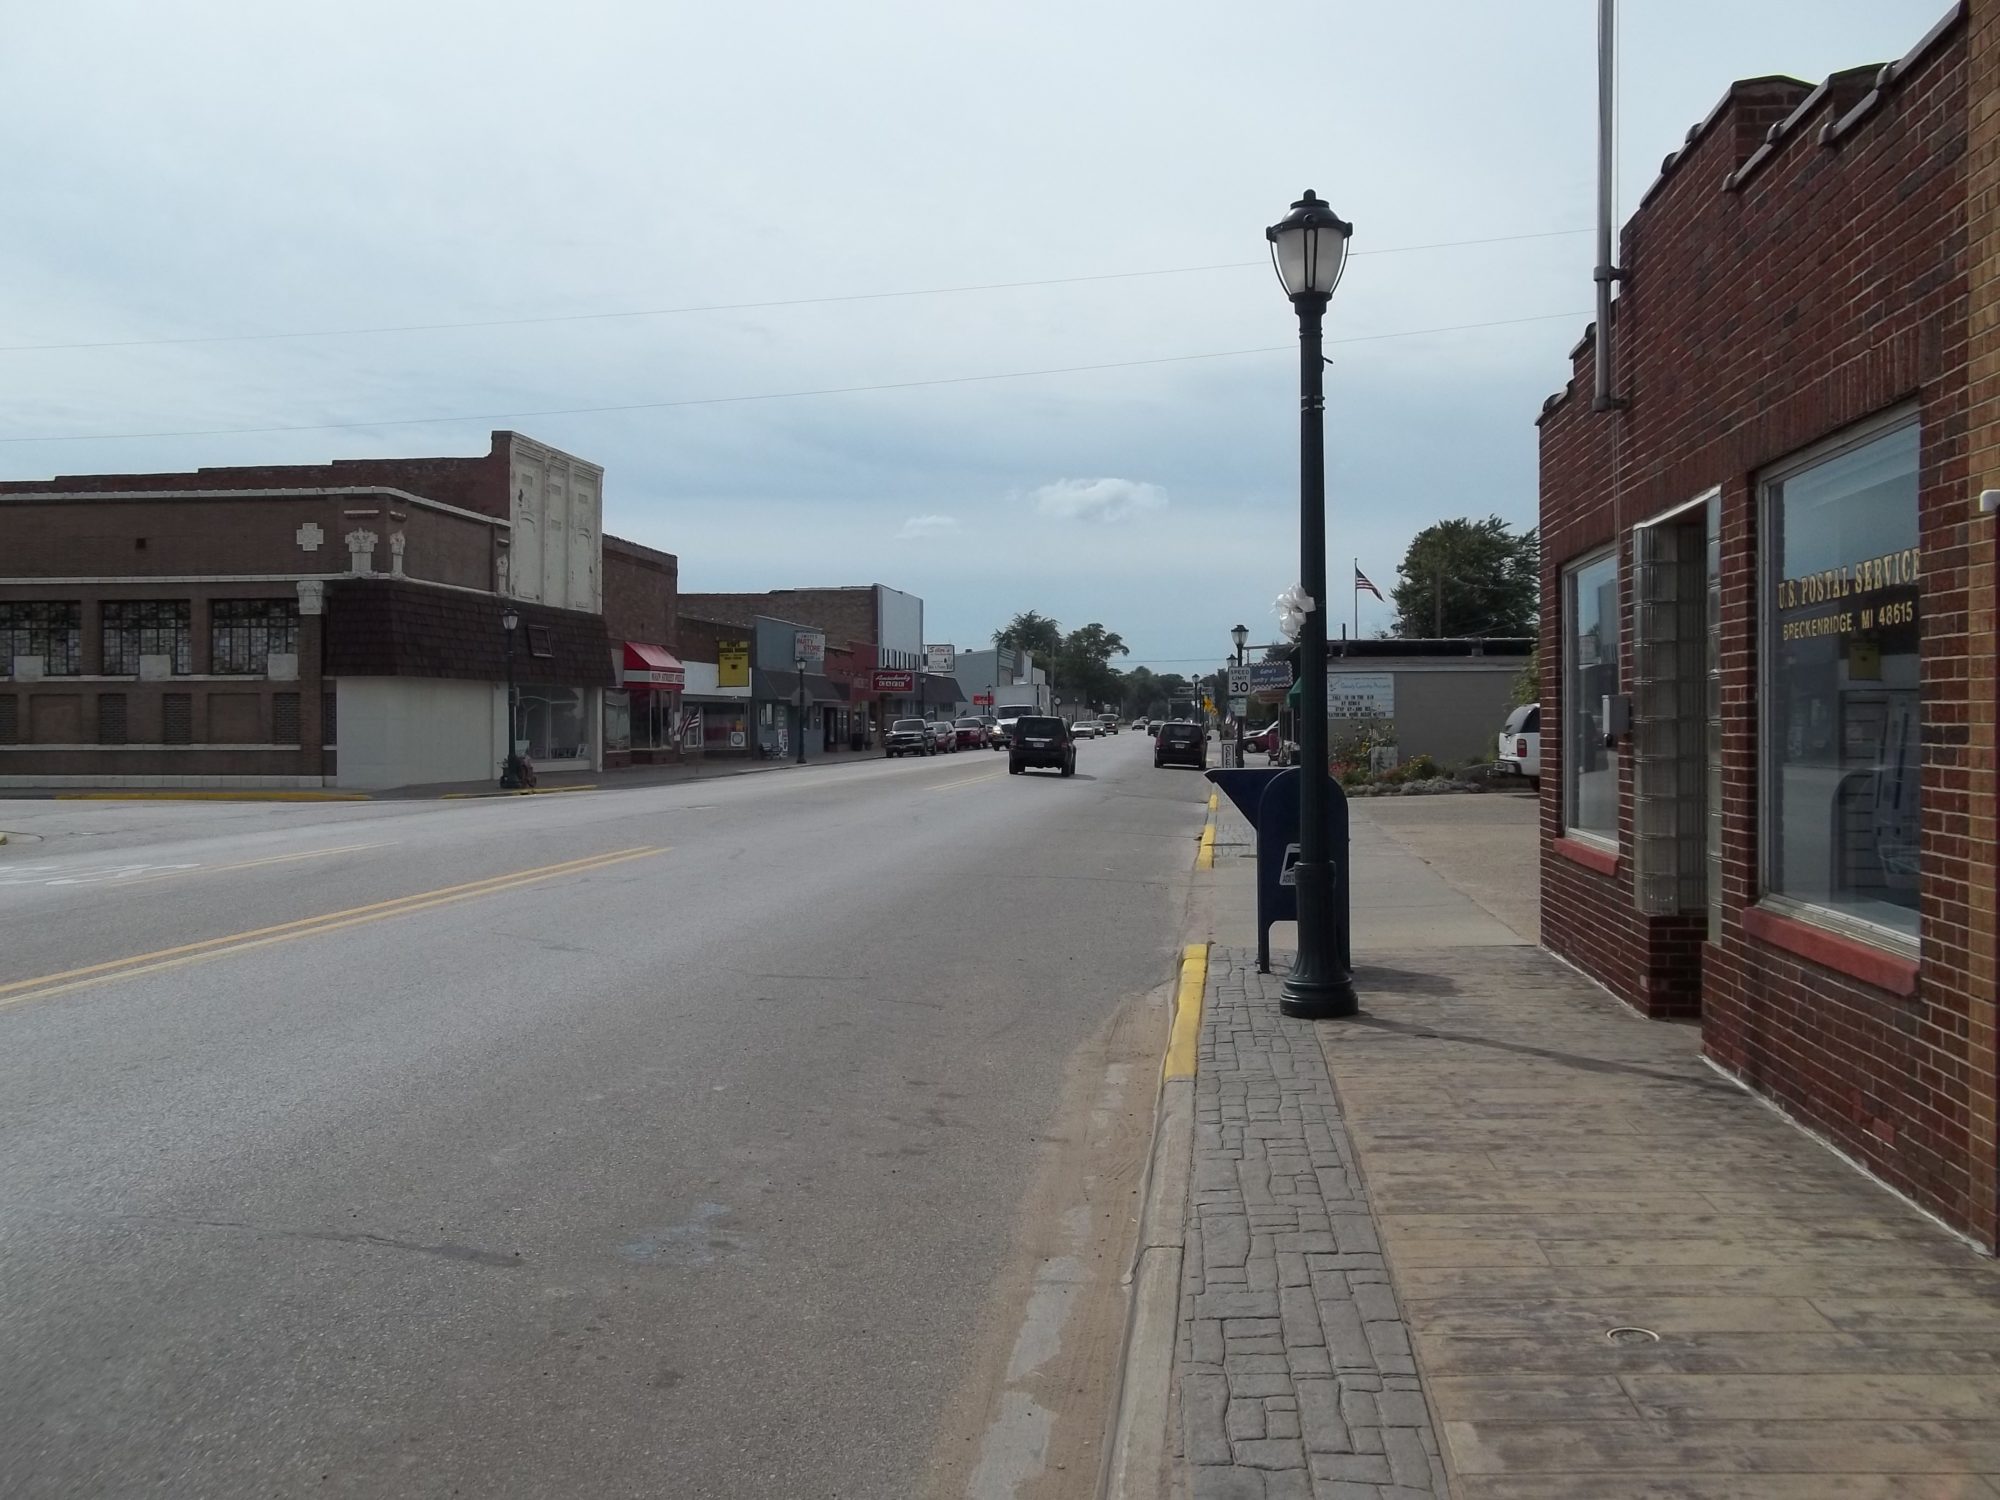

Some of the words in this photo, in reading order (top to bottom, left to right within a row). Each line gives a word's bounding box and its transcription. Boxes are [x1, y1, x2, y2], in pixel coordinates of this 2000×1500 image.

[1778, 580, 1798, 609] U.S.
[1801, 566, 1849, 606] POSTAL
[1855, 548, 1920, 594] SERVICE
[1861, 608, 1873, 629] MI
[1878, 600, 1913, 626] 48615
[1231, 681, 1249, 693] 30
